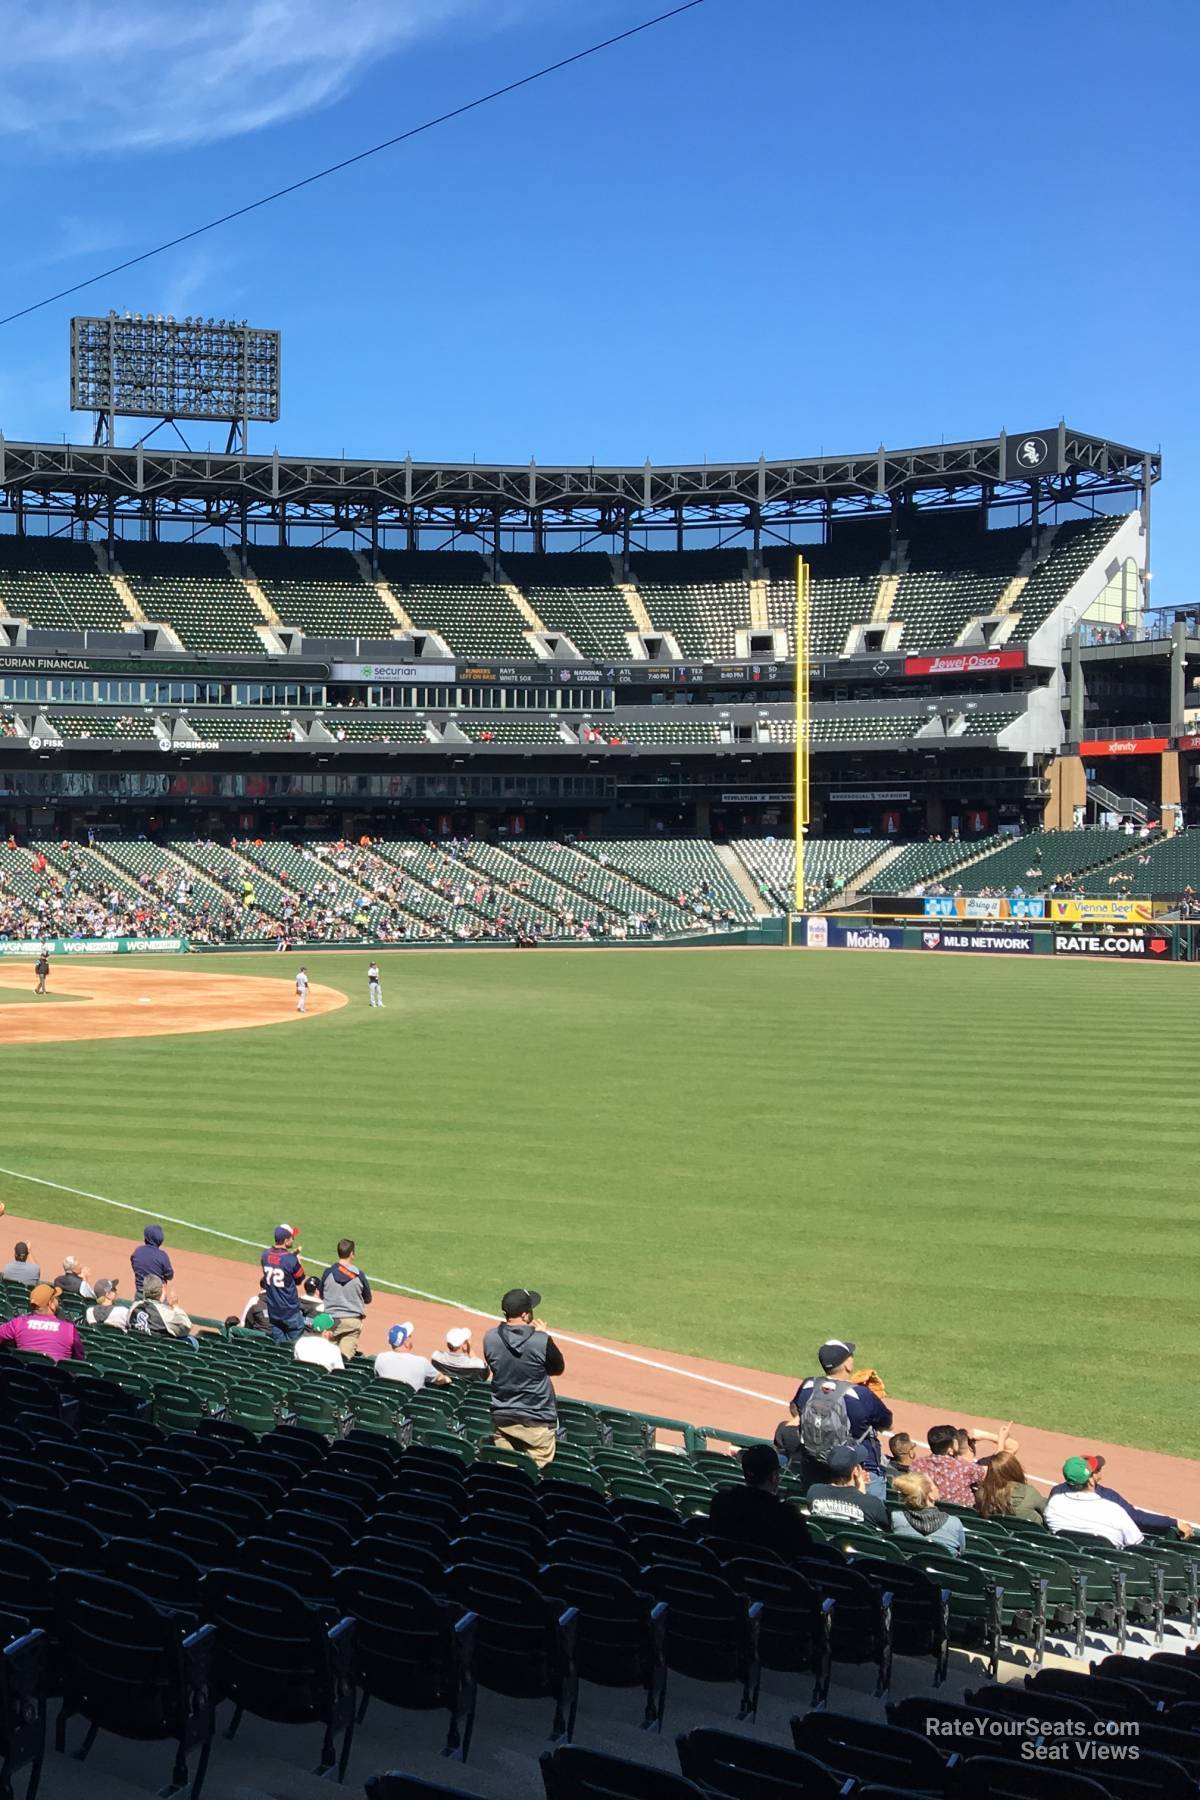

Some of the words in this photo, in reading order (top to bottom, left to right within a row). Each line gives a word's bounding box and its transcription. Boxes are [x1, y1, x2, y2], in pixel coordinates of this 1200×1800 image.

[37, 659, 90, 670] FINANCIAL
[931, 655, 1001, 669] Jewel-Osco
[374, 666, 417, 676] securian
[43, 739, 64, 748] FISK
[173, 741, 219, 749] ROBINSON
[1108, 742, 1138, 753] xfinity
[967, 900, 990, 910] Bring
[1074, 902, 1108, 912] Vienna
[1112, 902, 1134, 912] Beef
[846, 931, 890, 949] Modelo
[944, 936, 969, 947] MLB
[971, 938, 1030, 950] NETWORK
[1056, 936, 1145, 953] RATE.COM
[0, 943, 22, 952] WGN
[63, 942, 89, 952] WGN
[127, 942, 151, 951] WGN
[263, 1266, 285, 1288] 72
